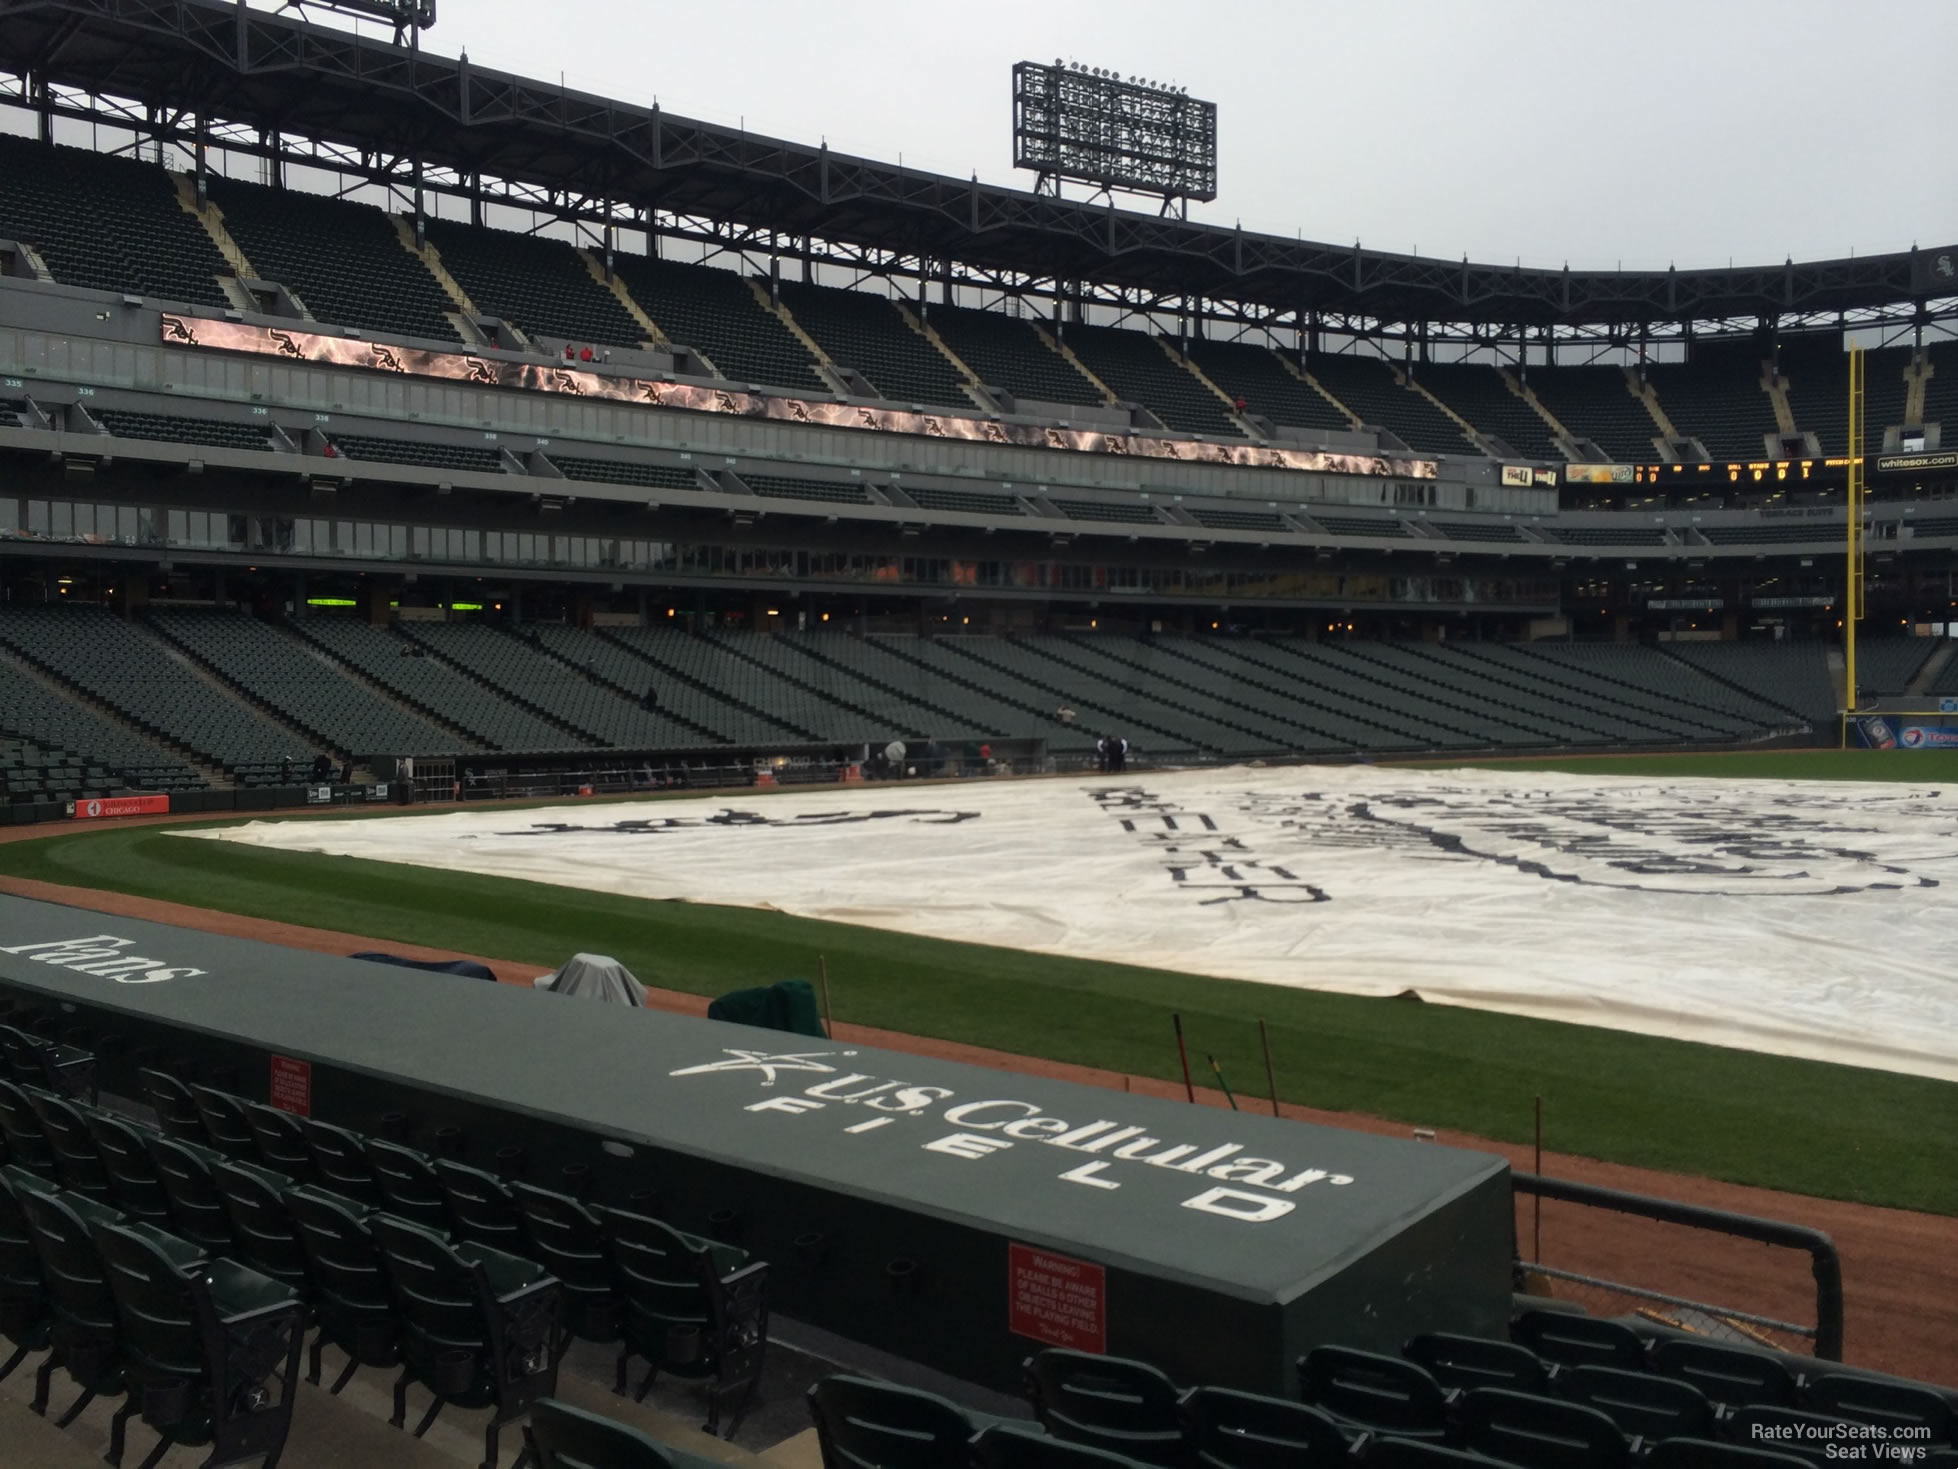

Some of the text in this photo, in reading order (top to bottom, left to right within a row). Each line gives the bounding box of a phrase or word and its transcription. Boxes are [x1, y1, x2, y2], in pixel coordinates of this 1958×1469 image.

[1881, 457, 1955, 468] whitesox.com
[105, 806, 140, 815] CHICAGO
[0, 935, 208, 983] Fans
[744, 1097, 1296, 1222] FIELD
[943, 1100, 1354, 1192] Cellular
[1017, 1267, 1097, 1298] PLEASE BE AWARE
[1017, 1279, 1028, 1289] OF
[1030, 1283, 1057, 1299] BALLS
[1066, 1294, 1097, 1310] OTHER
[1016, 1301, 1032, 1315] THE
[1033, 1307, 1070, 1326] PLAYING
[1018, 1290, 1095, 1321] OBJECTS LEAVING
